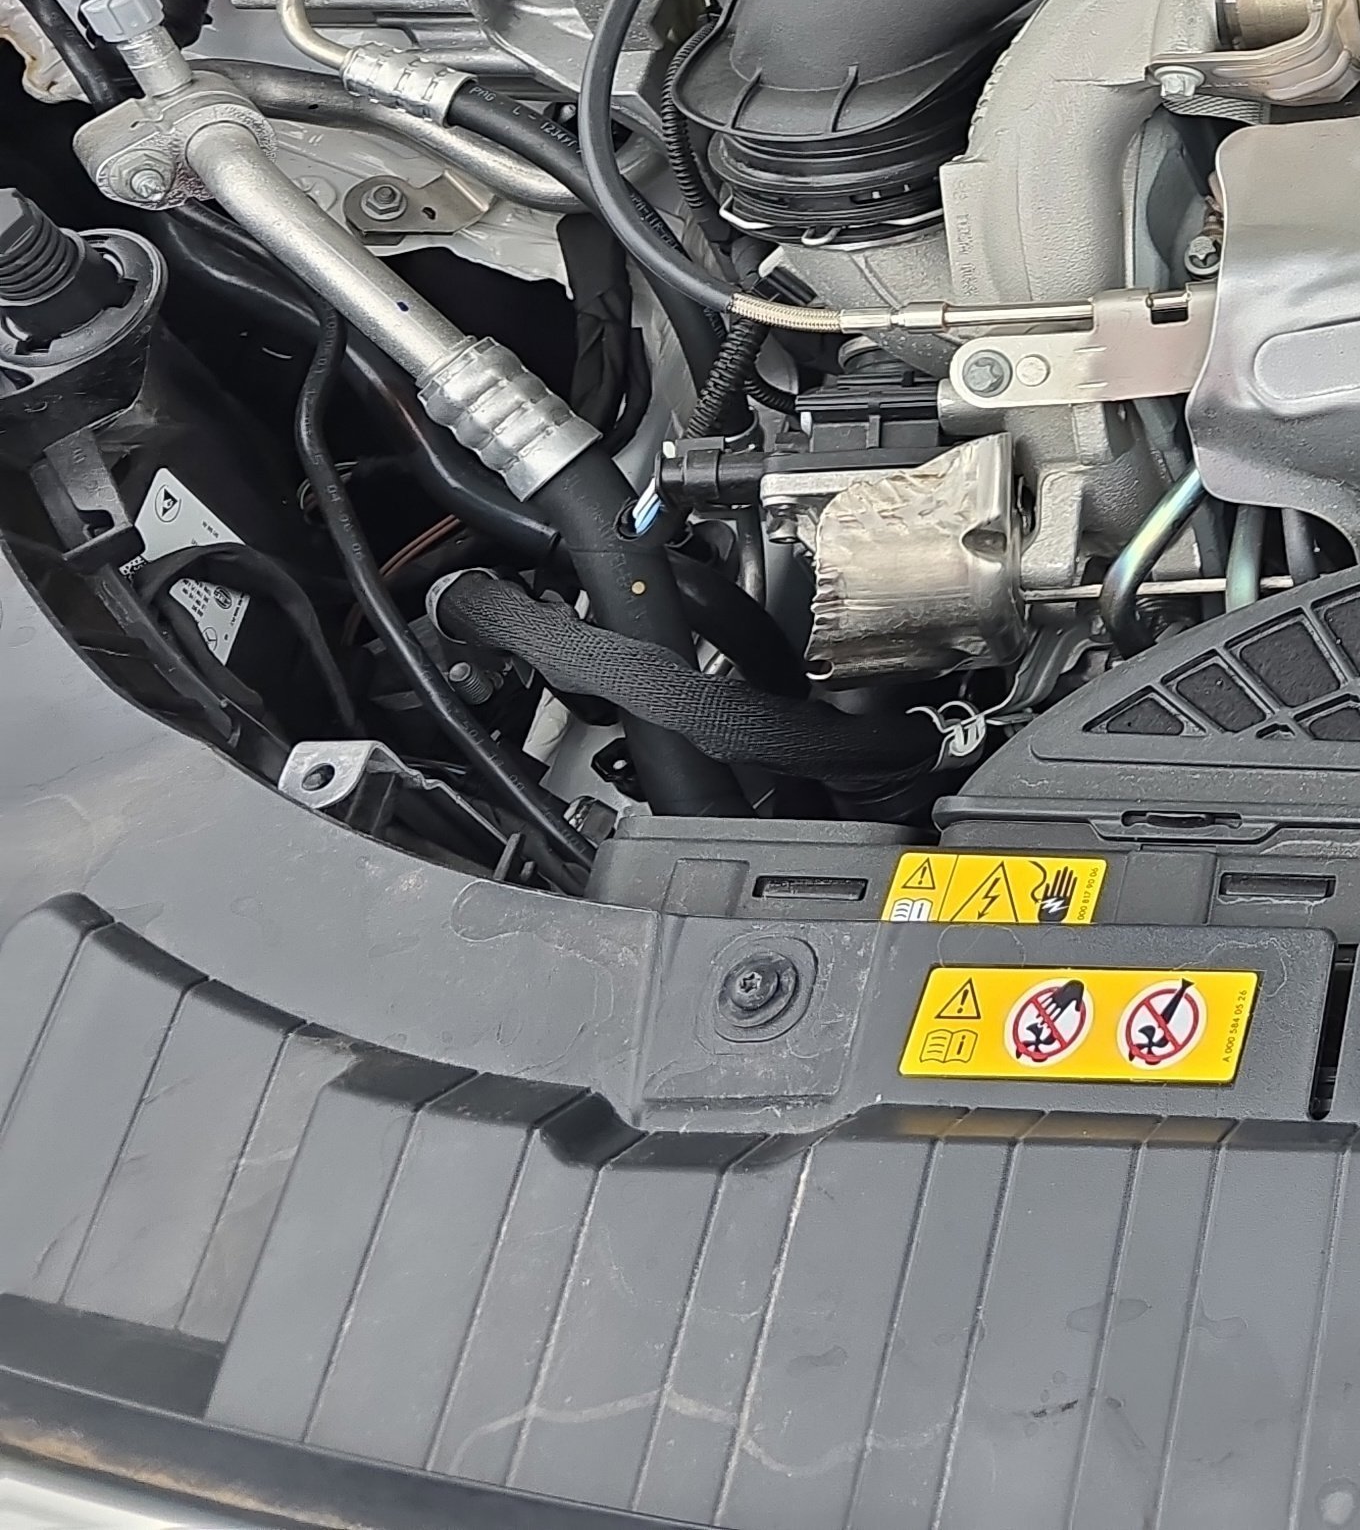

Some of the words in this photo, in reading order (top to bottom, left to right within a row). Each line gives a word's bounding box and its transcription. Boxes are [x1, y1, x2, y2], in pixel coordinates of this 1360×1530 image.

[1089, 867, 1099, 878] 06
[1086, 878, 1095, 889] 90
[1082, 891, 1091, 904] 817
[1077, 905, 1088, 920] 000
[1238, 989, 1248, 1002] 26
[1234, 1003, 1244, 1015] 05
[1229, 1017, 1240, 1034] 584
[1224, 1036, 1235, 1054] 000
[1222, 1055, 1231, 1063] A
